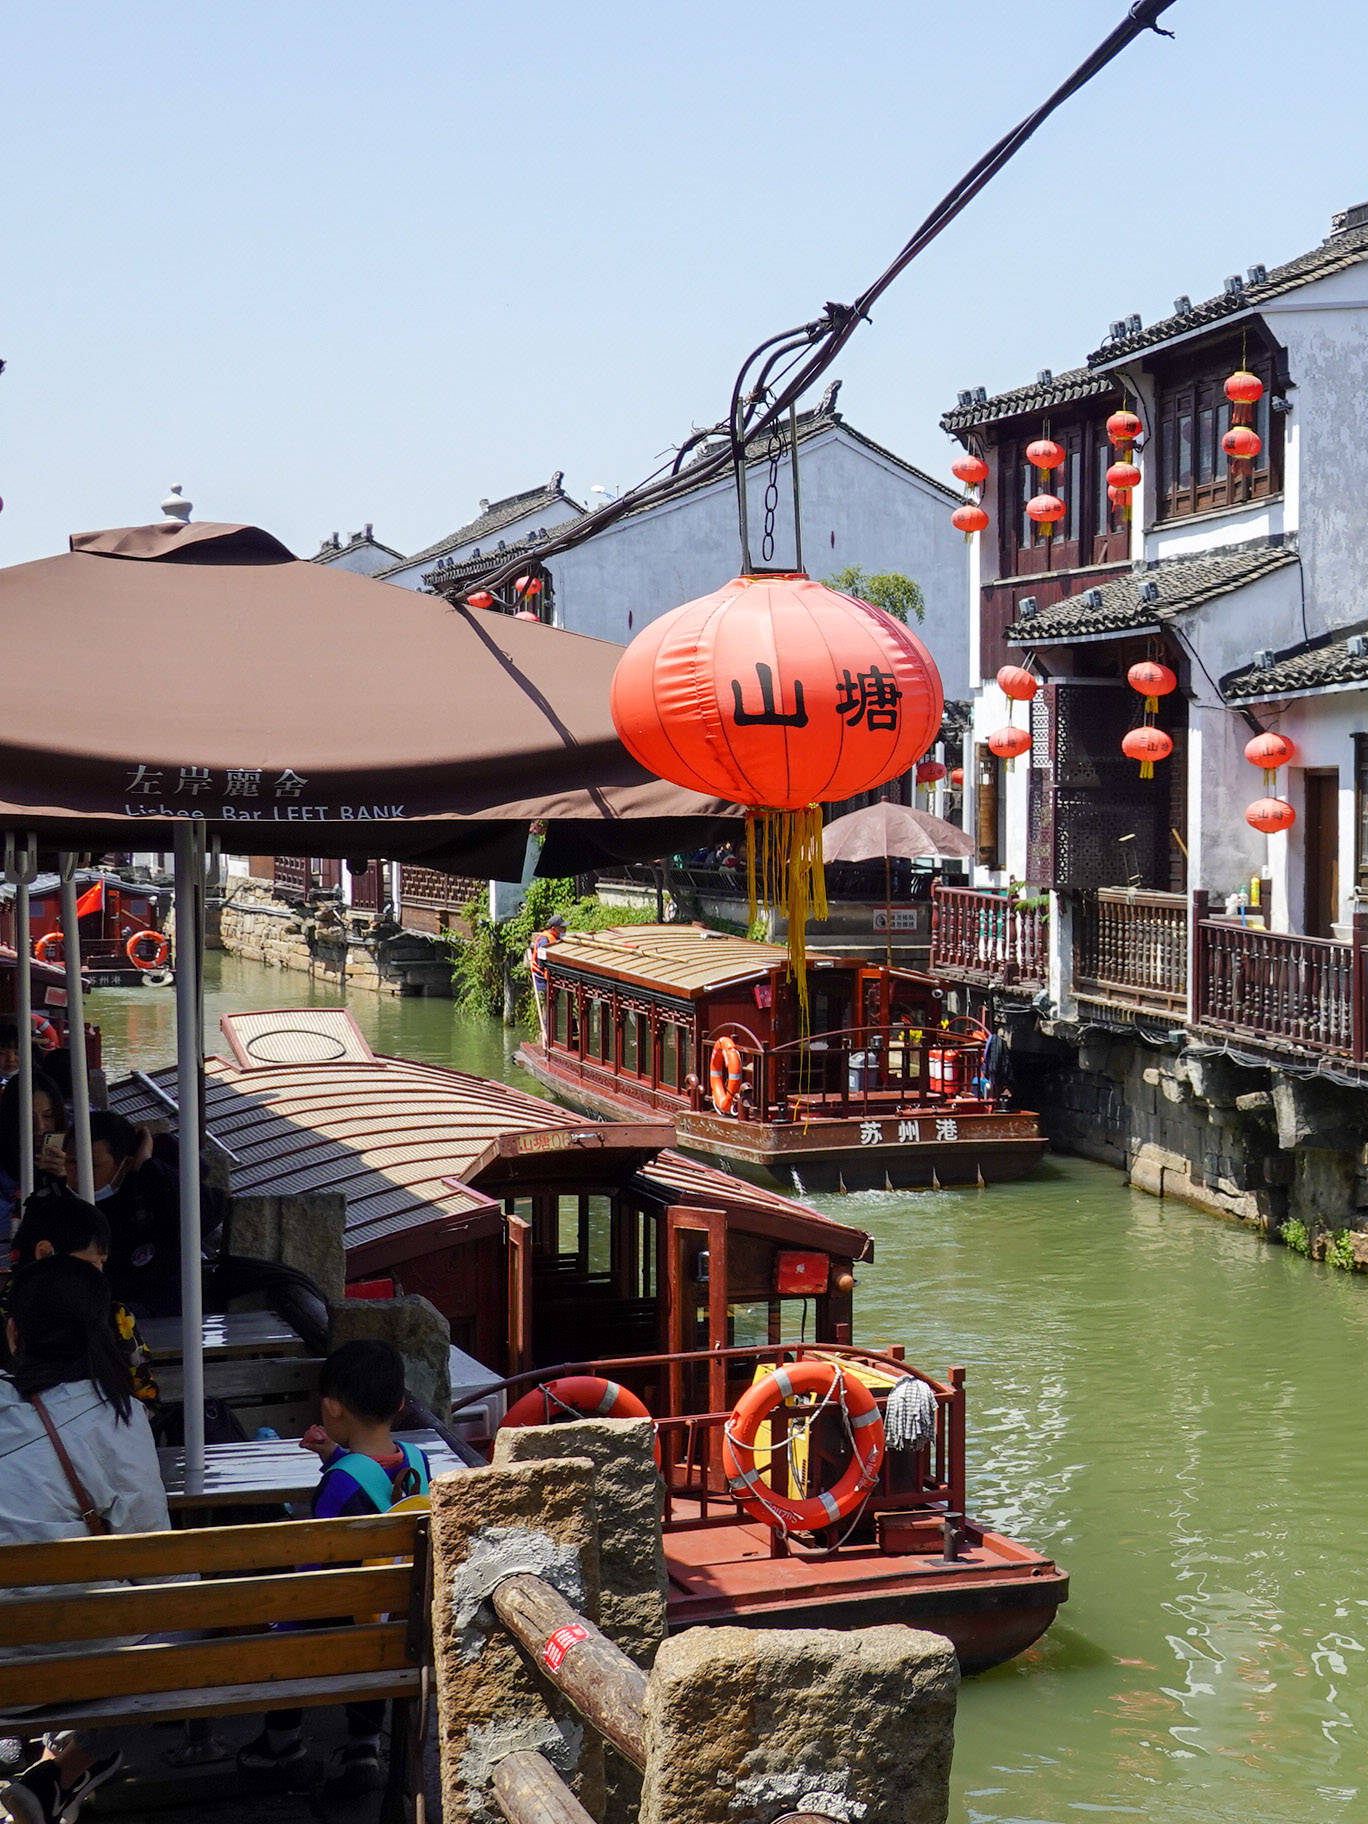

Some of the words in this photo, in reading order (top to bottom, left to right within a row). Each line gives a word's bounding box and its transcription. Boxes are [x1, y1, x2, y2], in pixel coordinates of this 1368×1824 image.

[731, 662, 903, 732] 山塘
[125, 764, 310, 798] 左岸麗舍
[222, 805, 262, 820] Bar
[340, 804, 408, 820] BANK
[860, 1118, 958, 1145] 苏州港
